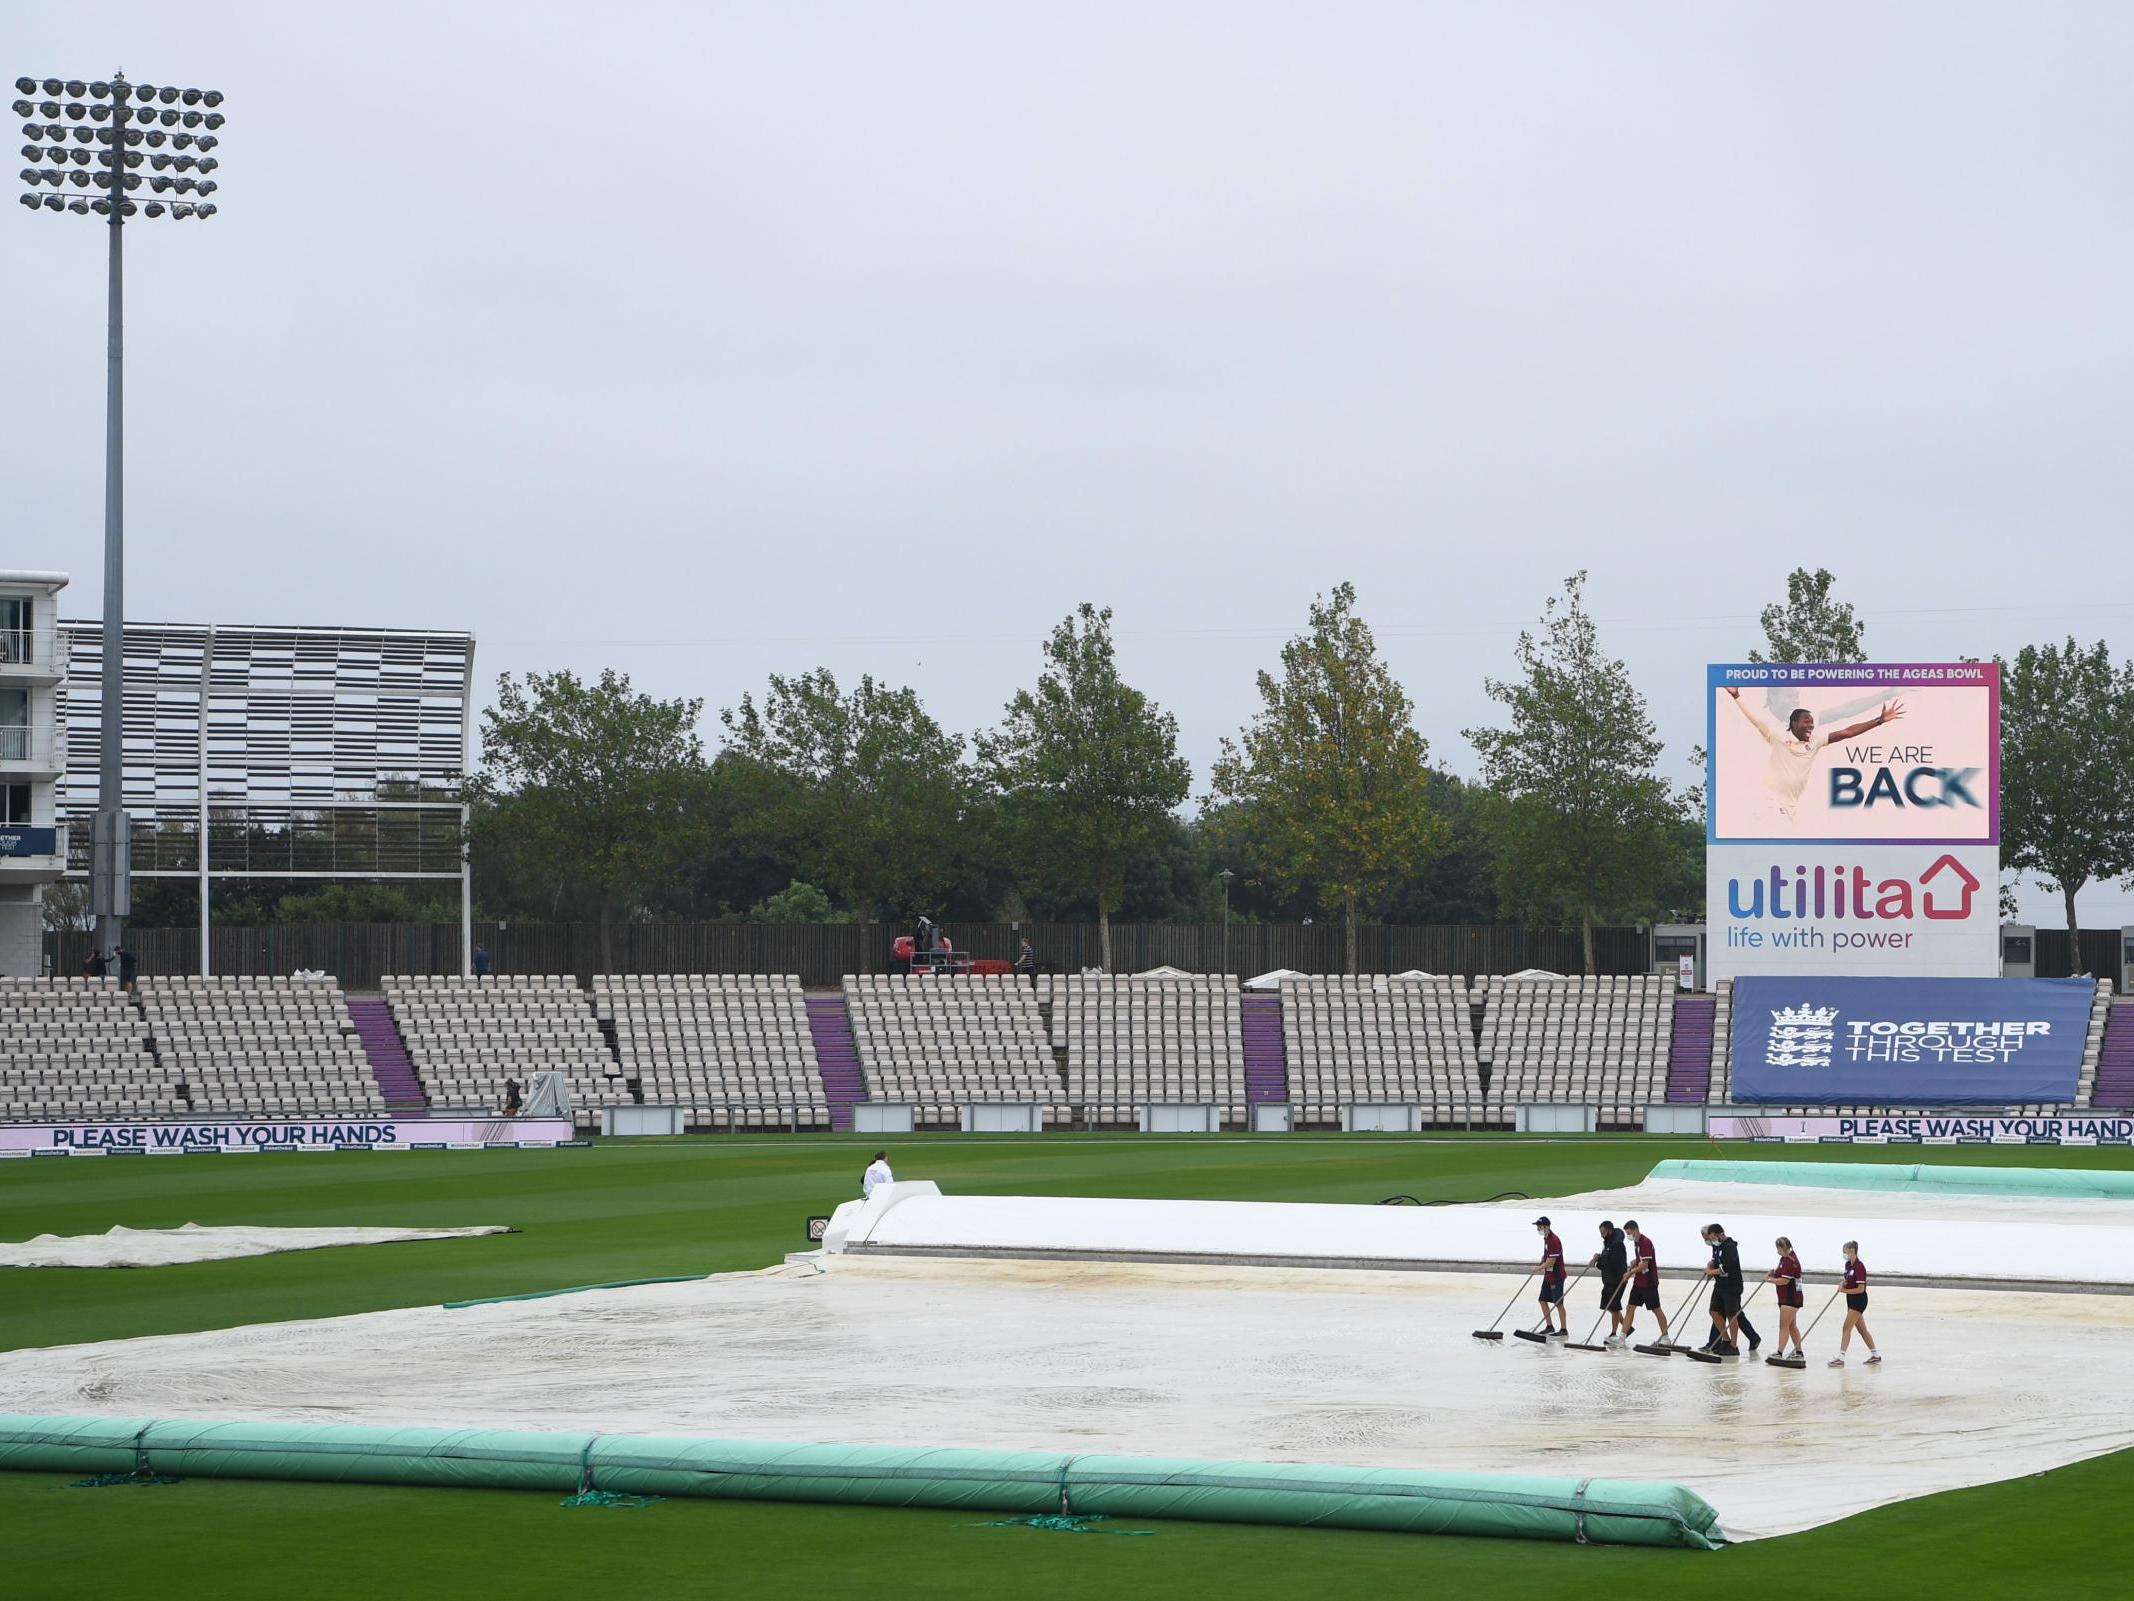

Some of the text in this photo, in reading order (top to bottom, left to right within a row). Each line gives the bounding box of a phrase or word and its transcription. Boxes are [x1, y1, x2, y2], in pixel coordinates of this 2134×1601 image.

[1726, 668, 1984, 680] PROUD TO BE POWERING THE AGEAS BOWL
[1846, 746, 1934, 764] WE ARE
[1828, 766, 1984, 809] BACK
[1728, 865, 1914, 920] utilita
[1728, 926, 1914, 954] life with power
[1847, 1021, 2052, 1035] TOGETHER
[1846, 1035, 2024, 1049] THROUGH
[1845, 1048, 2019, 1064] THIS TEST
[53, 1125, 397, 1147] PLEASE WASH YOUR HANDS
[1840, 1119, 2134, 1137] PLEASE WASH YOUR HAND
